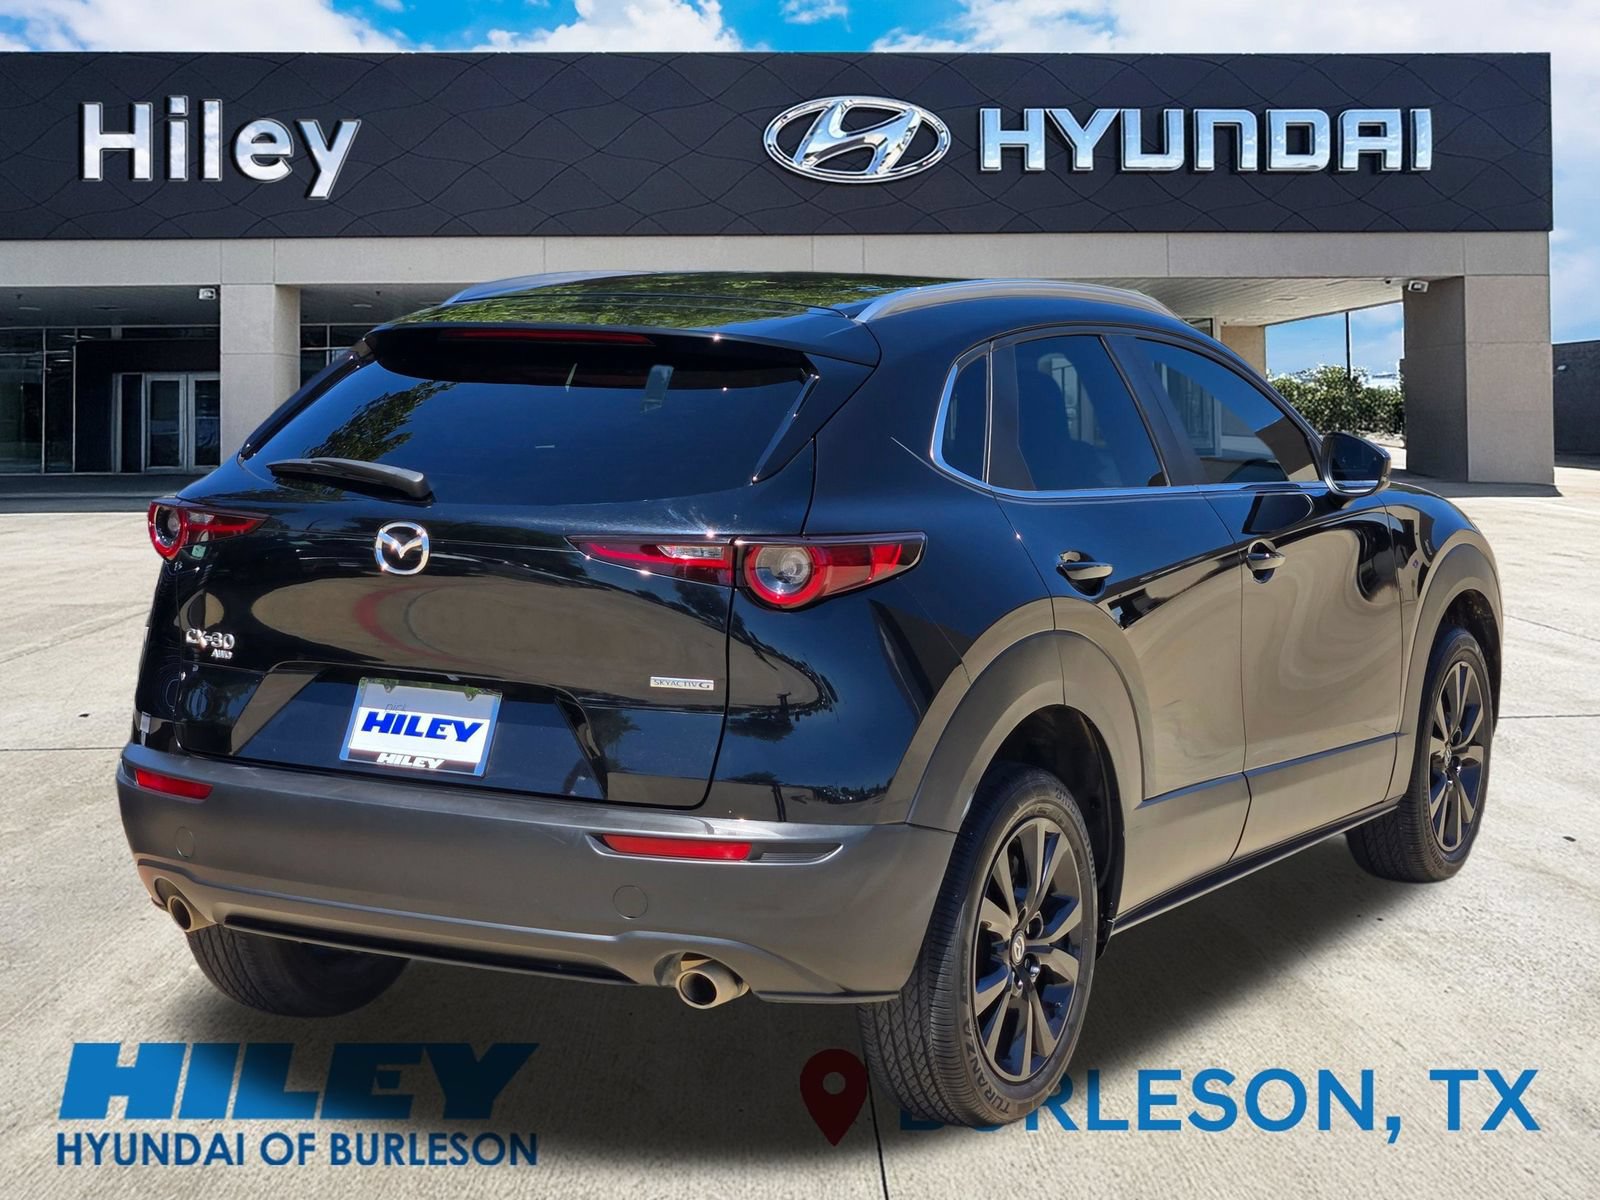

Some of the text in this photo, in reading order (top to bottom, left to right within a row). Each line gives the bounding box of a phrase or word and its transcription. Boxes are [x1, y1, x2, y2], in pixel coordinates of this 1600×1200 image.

[79, 95, 361, 200] Hiley
[979, 107, 1432, 172] HYUNDAI
[185, 628, 236, 650] CX-30
[361, 711, 484, 743] HILEY
[376, 752, 446, 769] HILEY
[963, 1019, 1010, 1114] TURANZA
